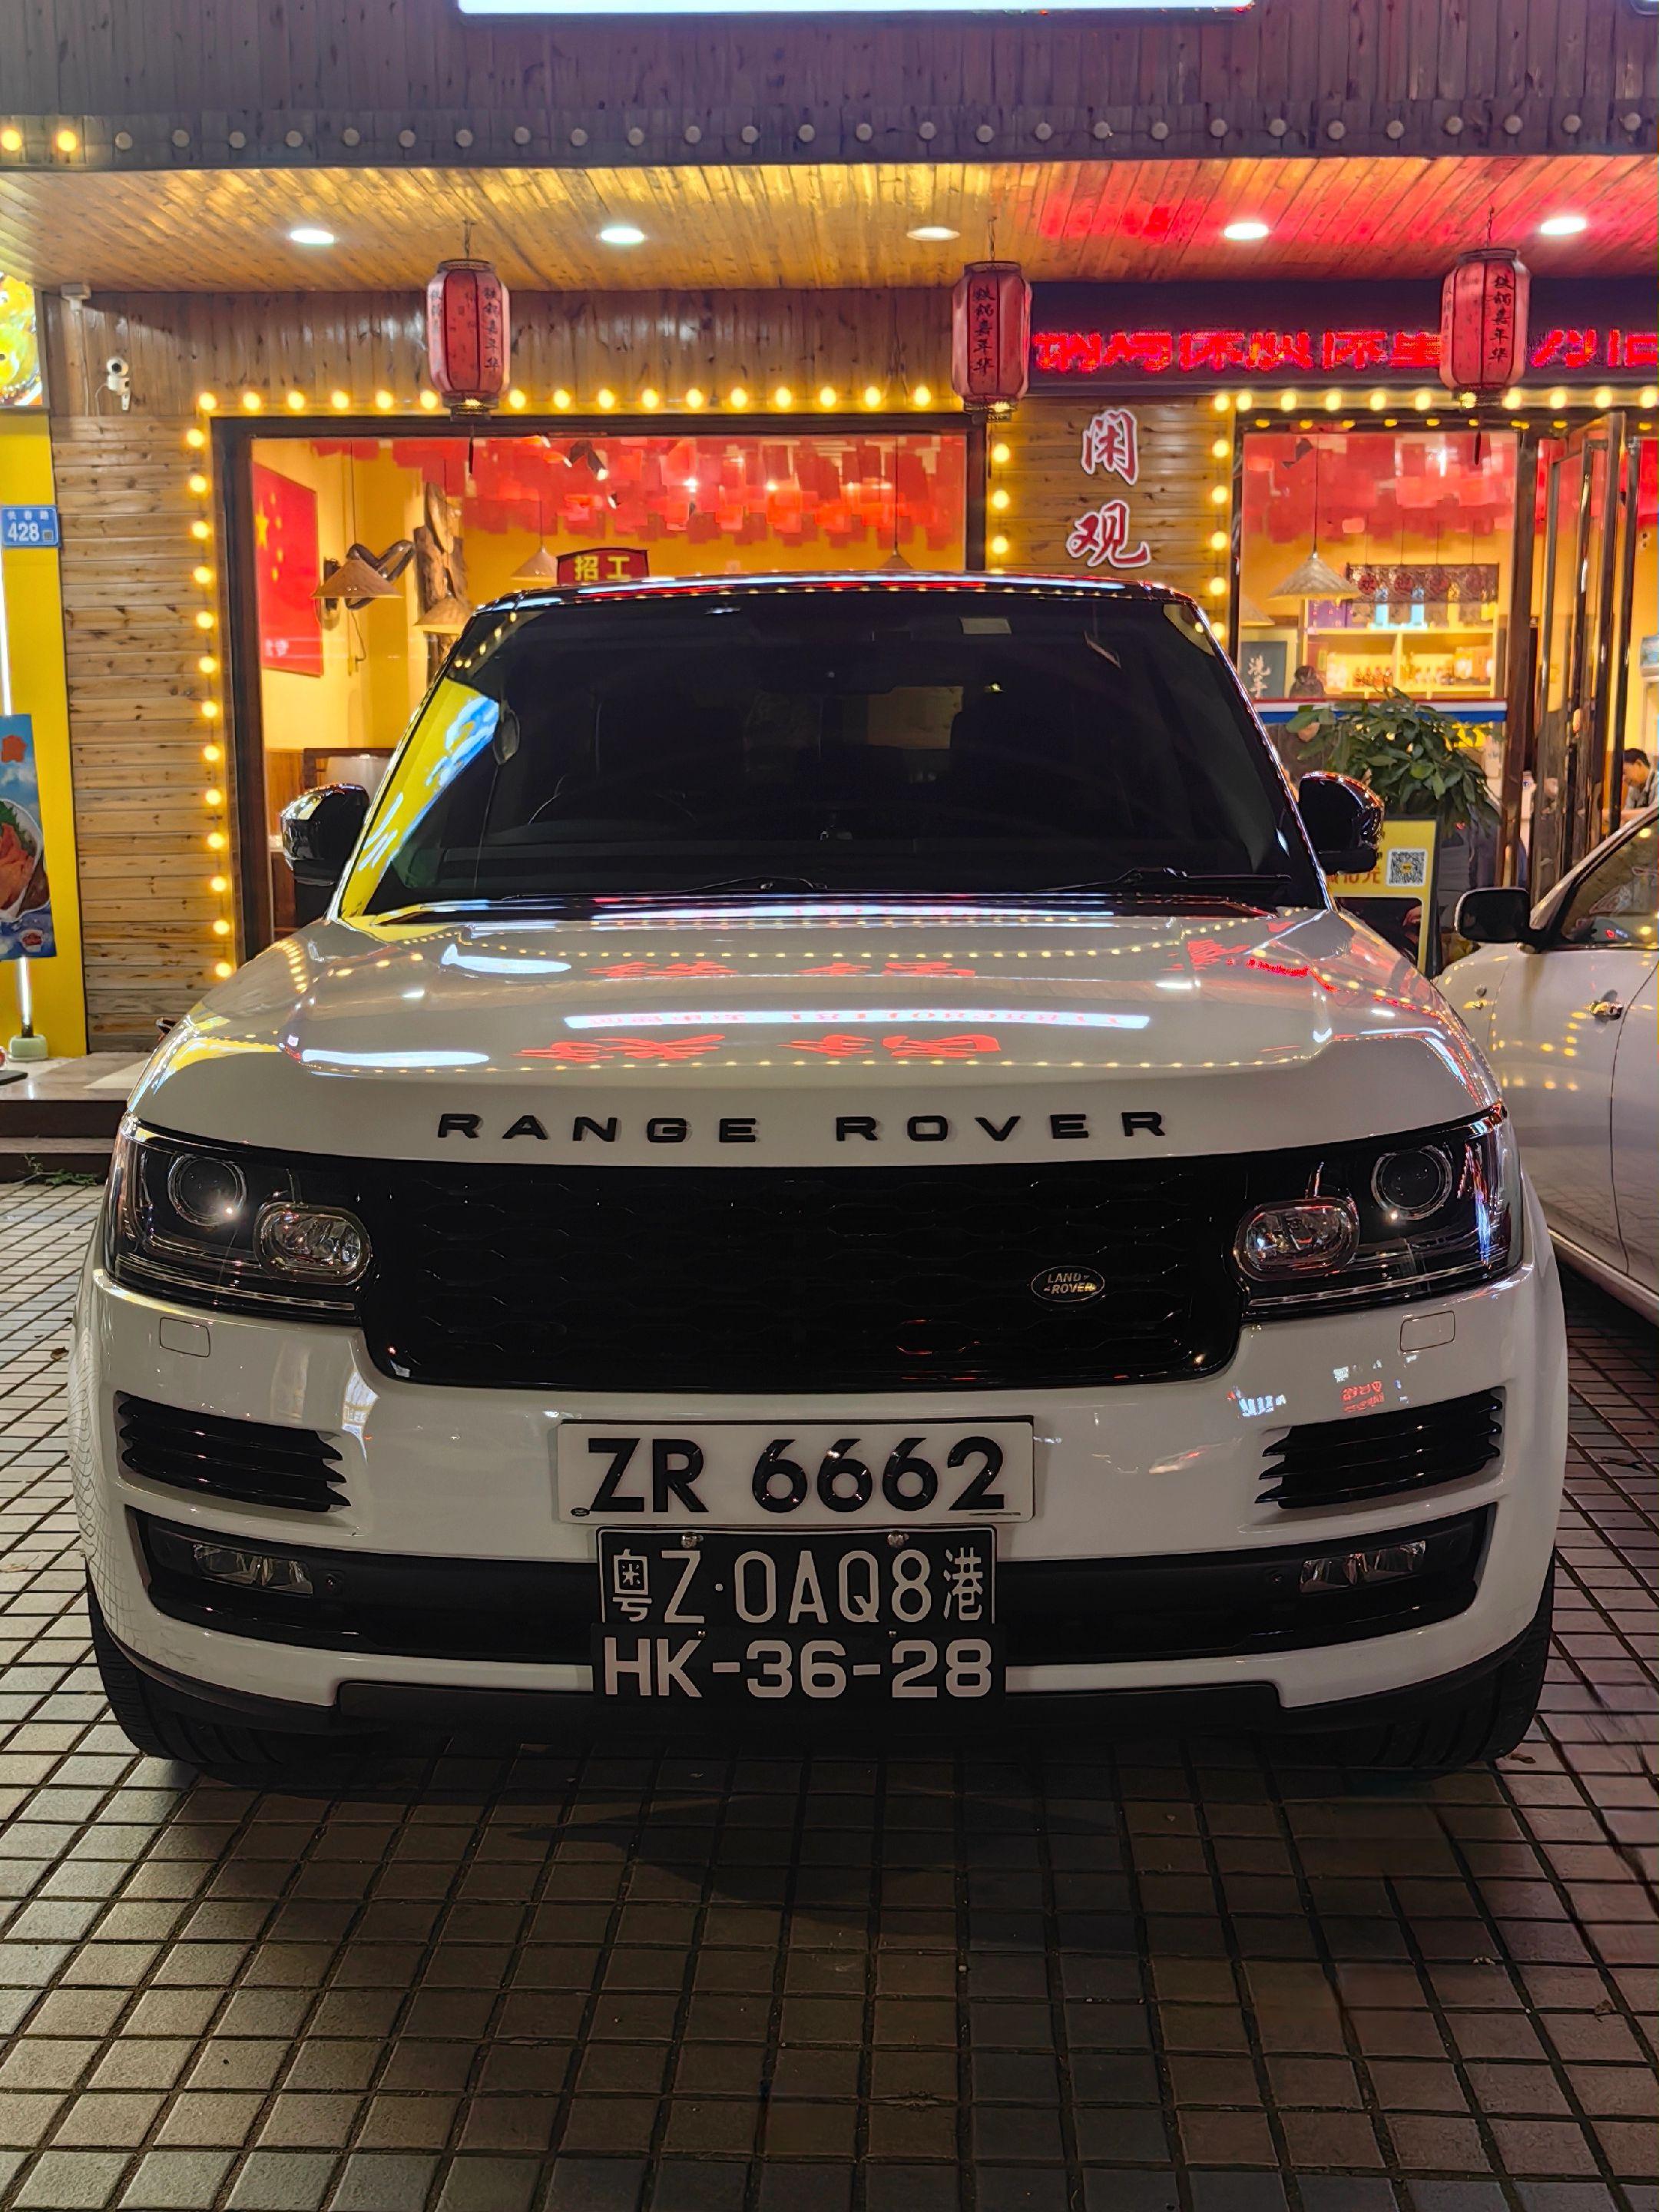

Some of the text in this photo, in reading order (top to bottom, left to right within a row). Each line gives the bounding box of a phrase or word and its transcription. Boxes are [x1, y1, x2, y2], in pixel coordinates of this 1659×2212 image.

[8, 522, 40, 541] 428
[574, 554, 632, 581] 招工
[437, 1111, 1166, 1143] RANGE ROVER
[1048, 1273, 1081, 1283] LAND
[1051, 1282, 1097, 1294] ROVER
[588, 1435, 1005, 1513] ZR 6662
[604, 1636, 992, 1699] HK-36-28
